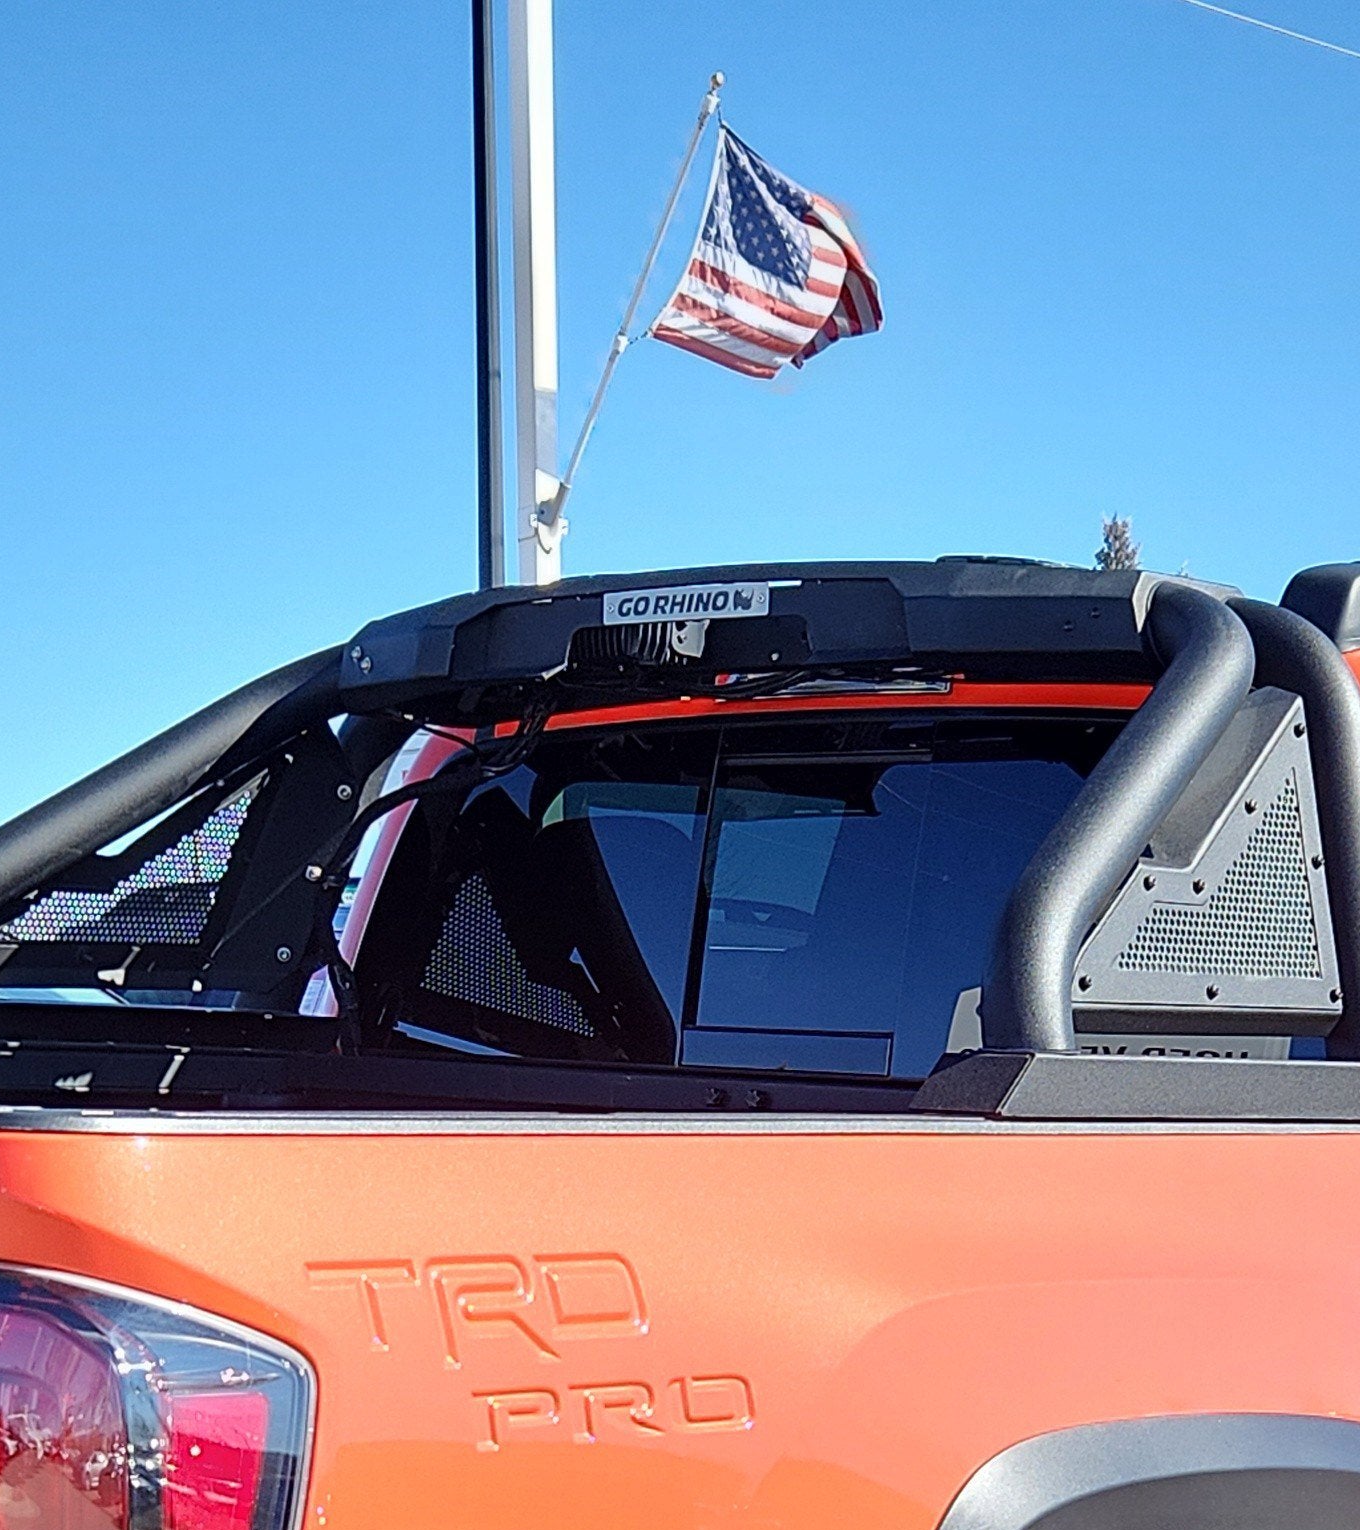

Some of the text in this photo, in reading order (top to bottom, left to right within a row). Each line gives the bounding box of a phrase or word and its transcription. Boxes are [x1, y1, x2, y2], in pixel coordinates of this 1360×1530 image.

[653, 589, 729, 616] RHINO
[304, 1251, 650, 1369] TRD
[471, 1374, 757, 1452] PRO
